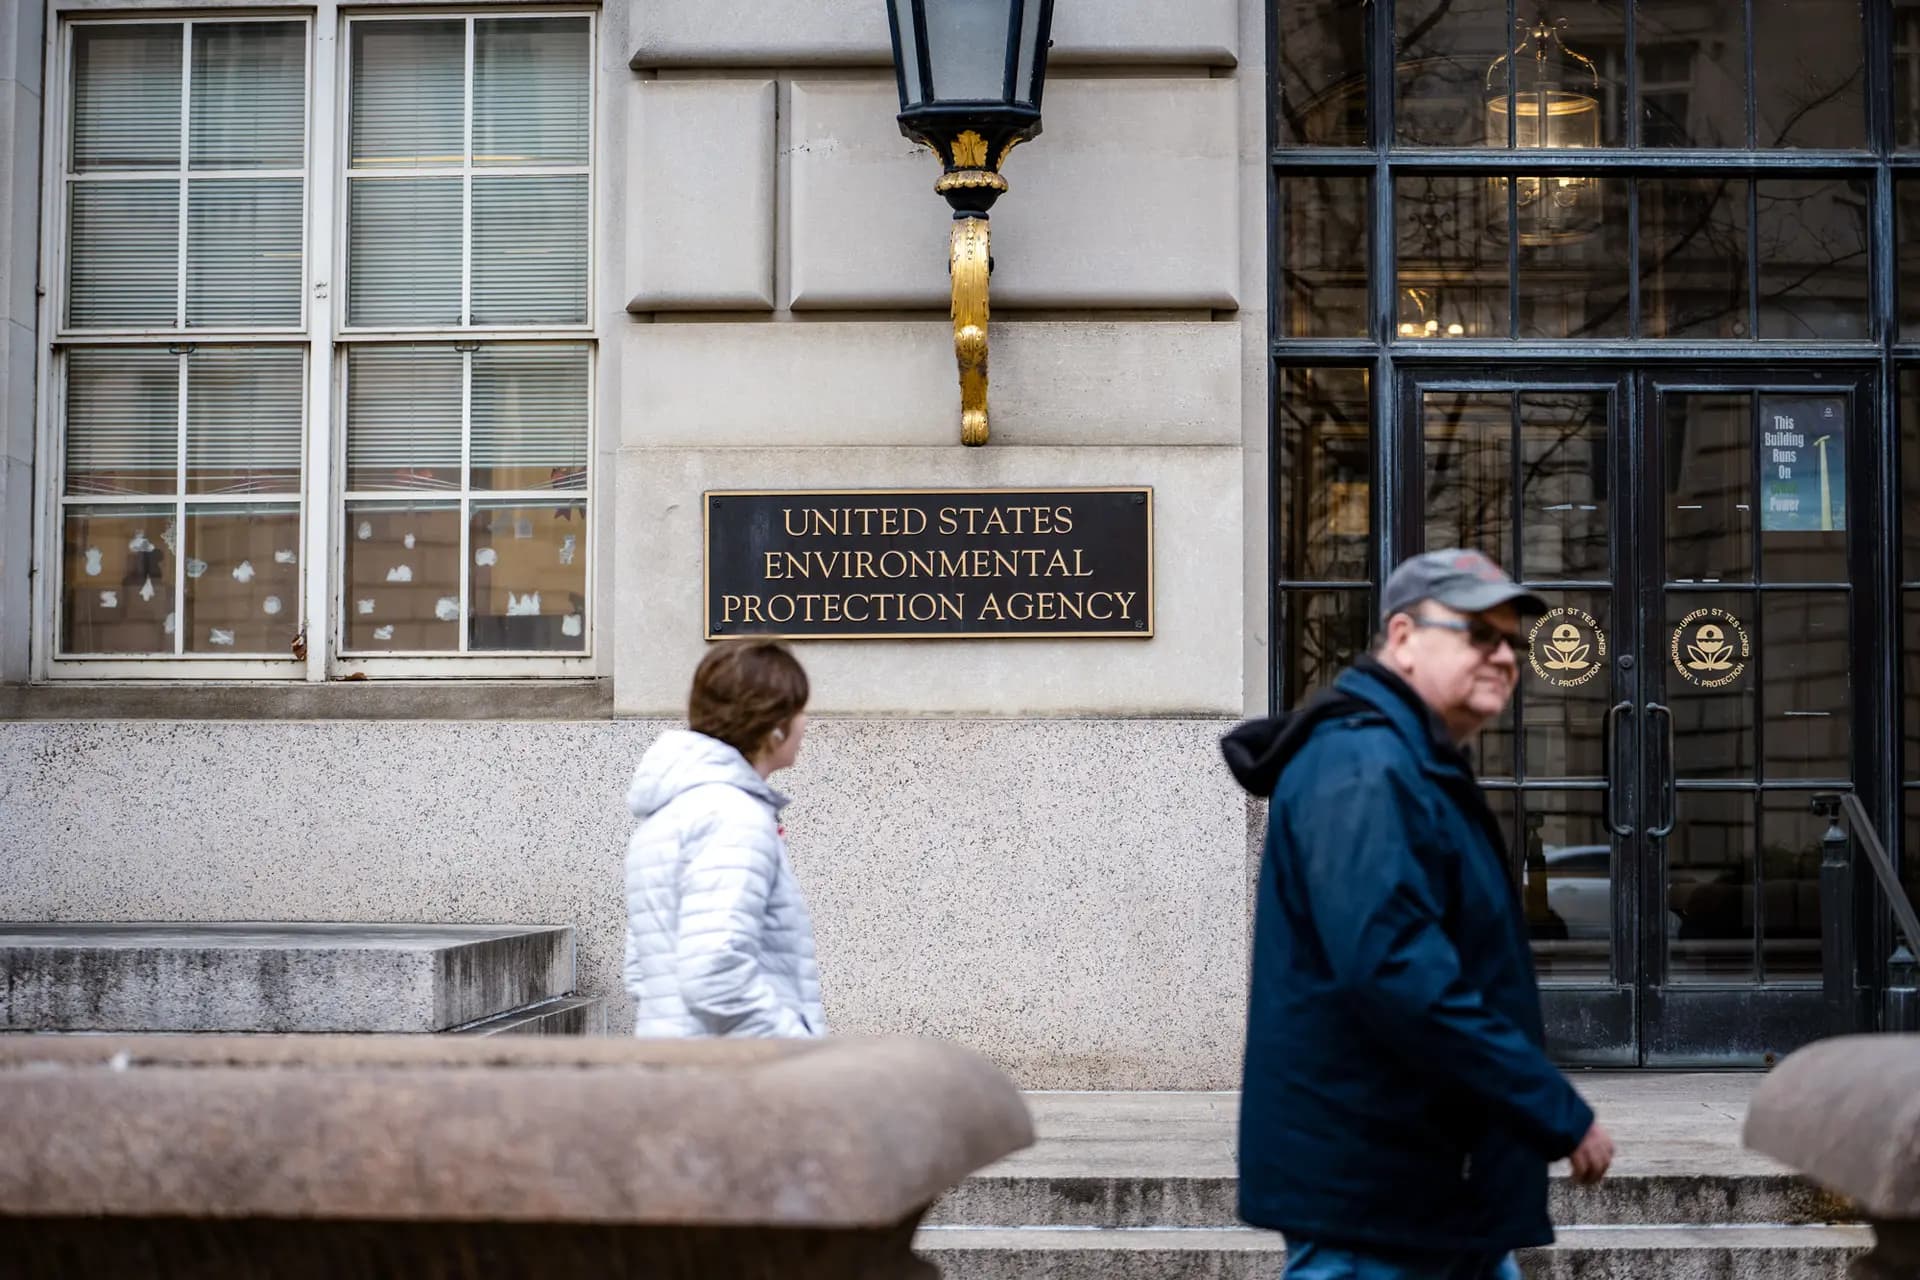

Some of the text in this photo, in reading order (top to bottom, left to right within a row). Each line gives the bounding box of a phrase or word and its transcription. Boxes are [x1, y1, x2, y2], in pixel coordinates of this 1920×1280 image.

[1774, 415, 1794, 430] This
[1764, 432, 1804, 448] Building
[1773, 449, 1797, 462] Runs
[1778, 465, 1791, 479] On
[783, 506, 1073, 536] UNITED STATES
[764, 549, 1094, 580] ENVIRONMENTAL
[721, 591, 1136, 623] PROTECTION AGENCY
[1536, 607, 1597, 627] UNITED STTES
[1679, 608, 1740, 628] UNITED STTES
[1558, 661, 1602, 687] PROTECTION
[1701, 662, 1745, 688] PROTECTION
